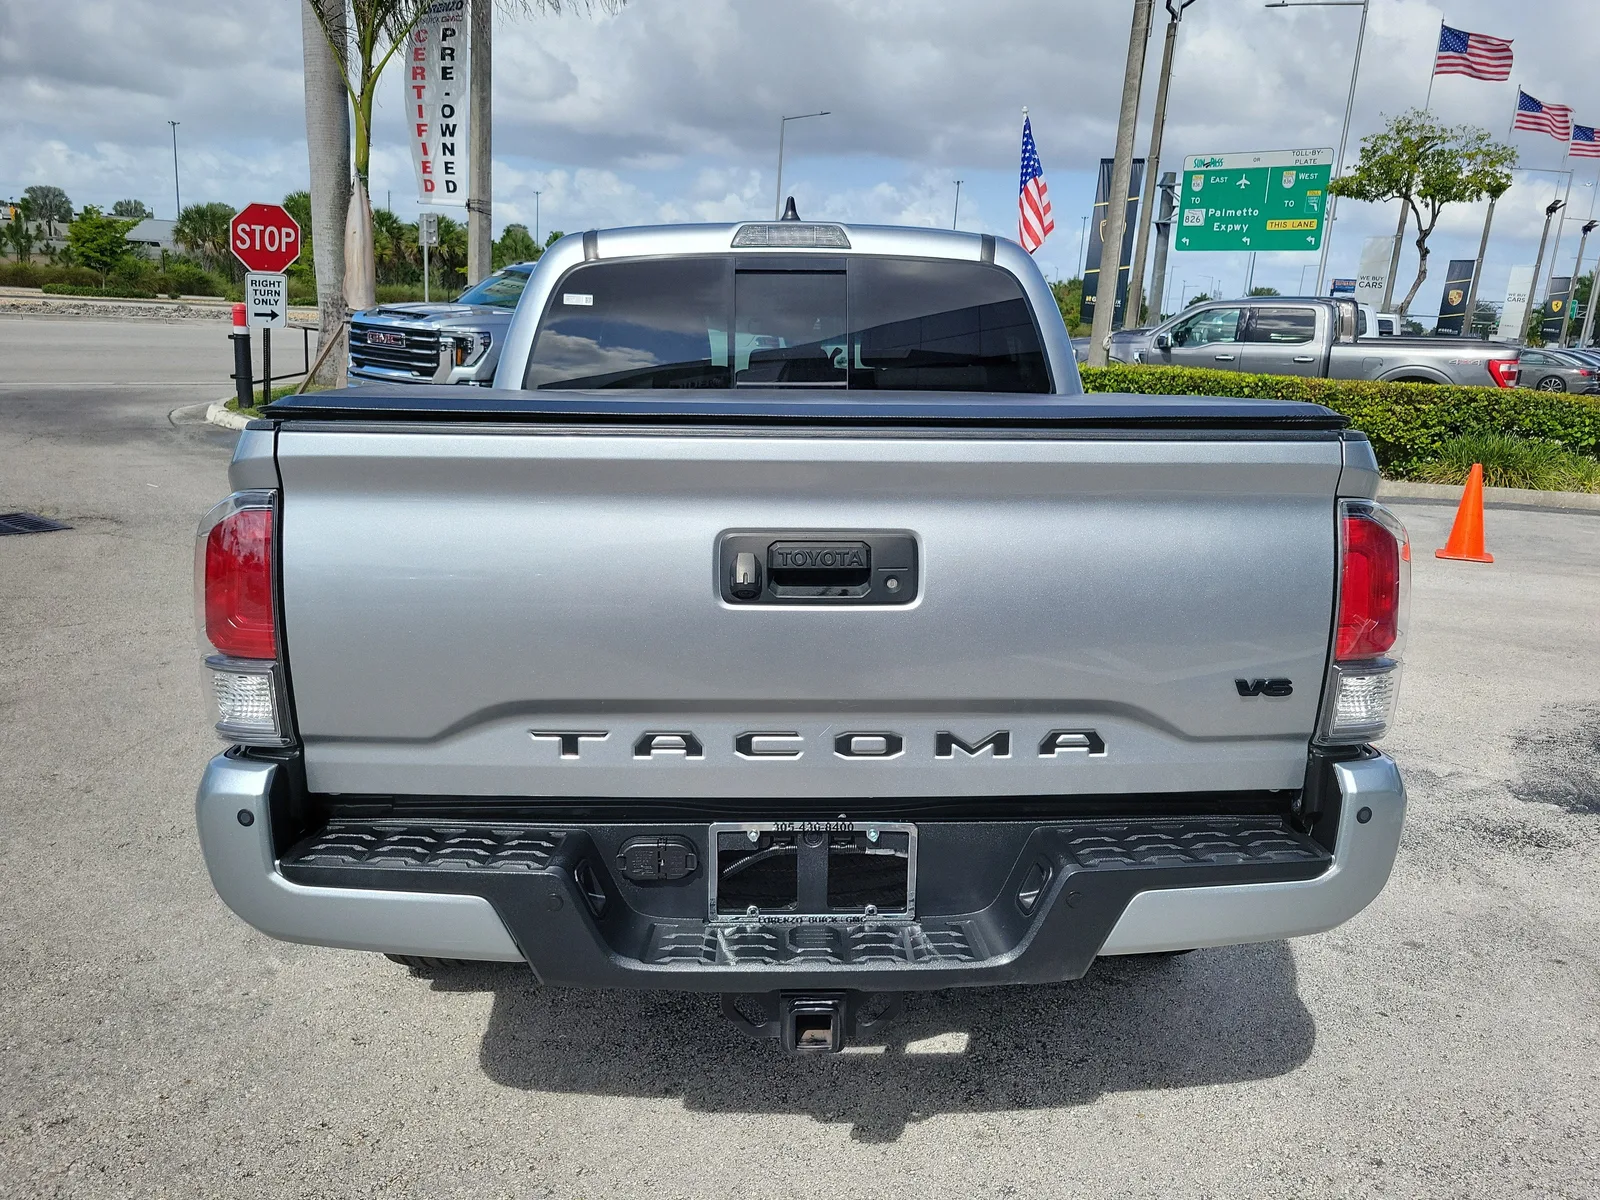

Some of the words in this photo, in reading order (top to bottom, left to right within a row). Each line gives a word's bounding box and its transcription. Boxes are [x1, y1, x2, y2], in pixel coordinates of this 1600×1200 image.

[411, 29, 436, 193] CERTIFIED
[440, 27, 457, 194] PRE-OWNED
[1210, 176, 1228, 184] EAST
[1298, 172, 1318, 180] WEST
[1284, 200, 1295, 208] TO
[1184, 215, 1201, 223] 826
[1208, 207, 1260, 217] Palmetto
[1213, 222, 1249, 233] Expwy
[1269, 221, 1288, 229] THIS
[1291, 220, 1315, 228] LANE
[235, 223, 296, 253] STOP
[250, 279, 282, 288] RIGHT
[1358, 281, 1383, 289] CARS
[252, 288, 281, 297] TURN
[253, 297, 280, 306] ONLY
[778, 550, 863, 567] TOYOTA
[1235, 678, 1293, 697] V6
[528, 728, 1108, 761] TACOMA
